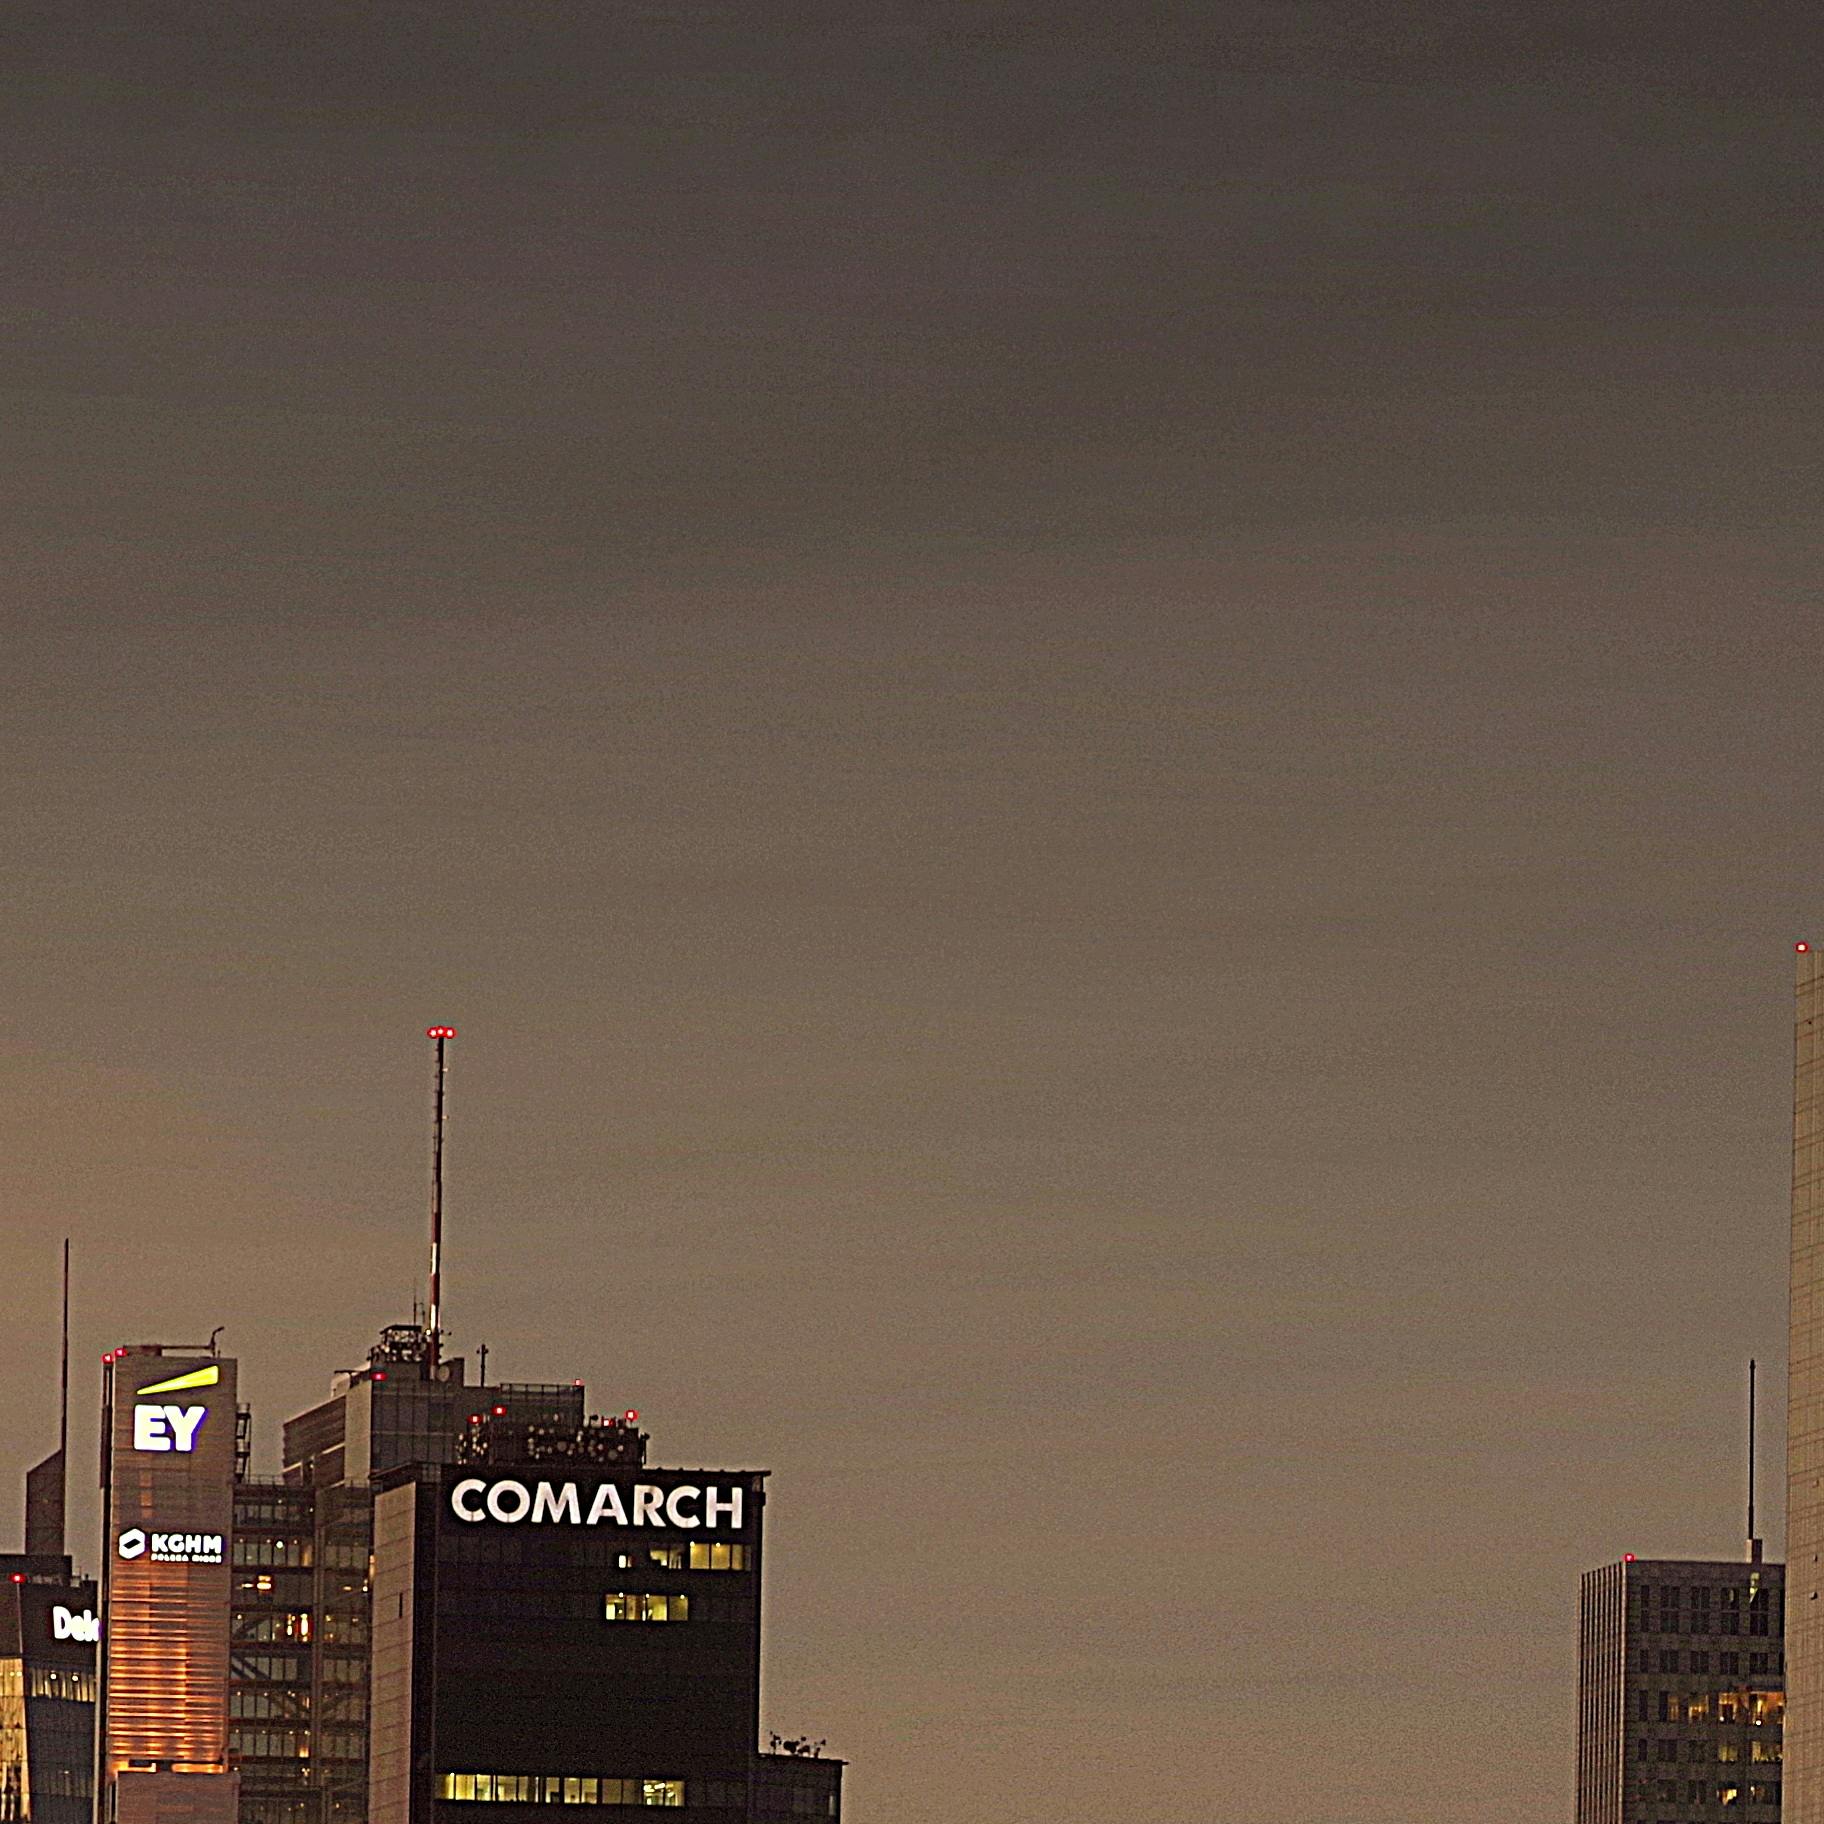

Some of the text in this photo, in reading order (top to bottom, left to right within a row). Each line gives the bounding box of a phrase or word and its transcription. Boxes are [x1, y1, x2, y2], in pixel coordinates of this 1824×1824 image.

[133, 1403, 206, 1451] EY
[451, 1478, 743, 1529] COMARCH
[151, 1533, 222, 1554] KGHM
